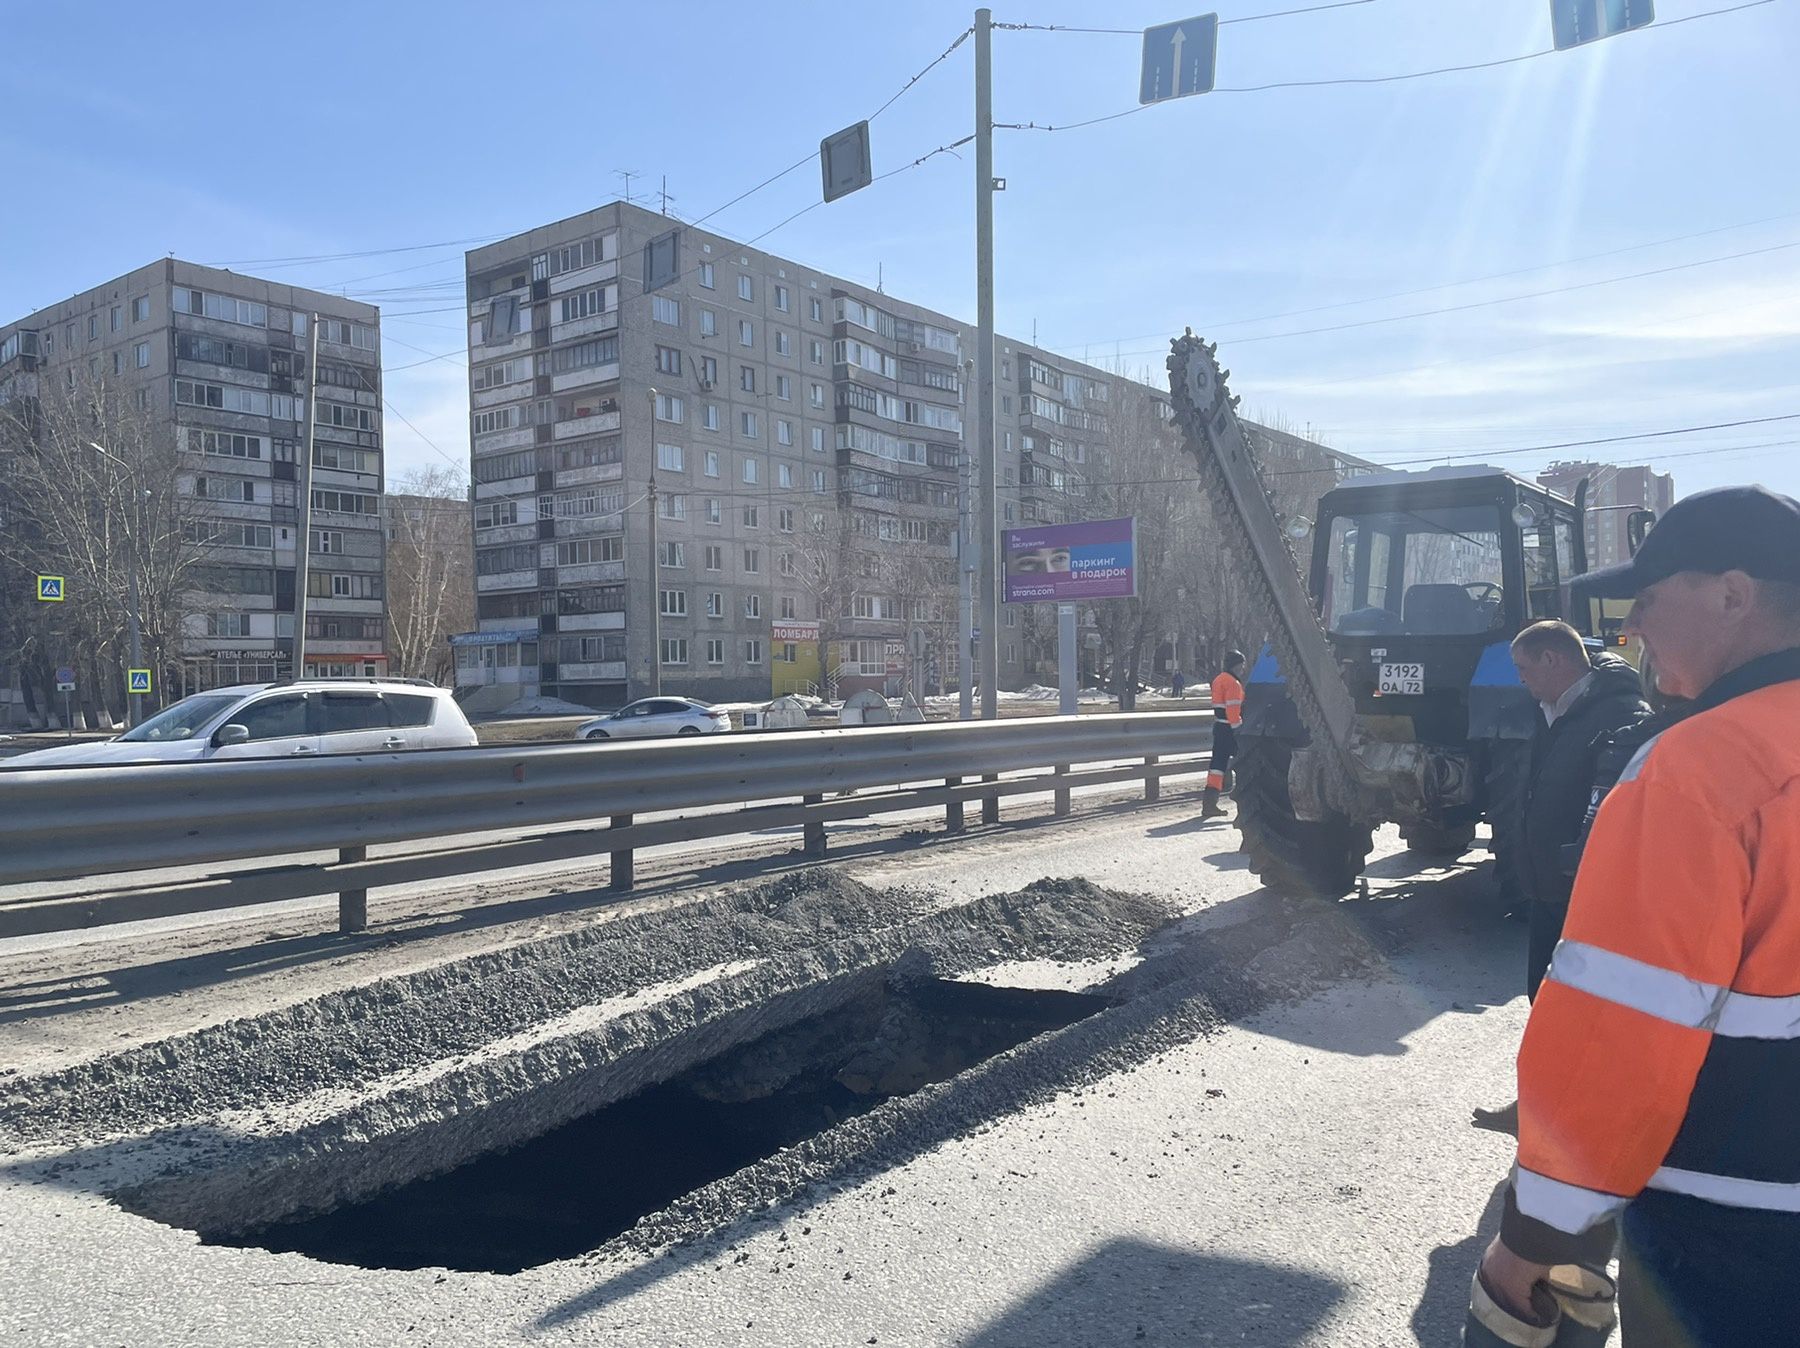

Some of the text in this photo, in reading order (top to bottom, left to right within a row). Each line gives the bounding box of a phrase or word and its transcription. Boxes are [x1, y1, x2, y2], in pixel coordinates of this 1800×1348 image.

[1071, 558, 1116, 570] паркинг
[1072, 568, 1127, 579] в подарок
[1012, 588, 1054, 597] strana.com
[773, 628, 820, 640] ЛОМБАРД
[217, 651, 242, 659] АТЕЛЬЕ
[1384, 665, 1419, 678] 3192
[1406, 682, 1420, 692] 72
